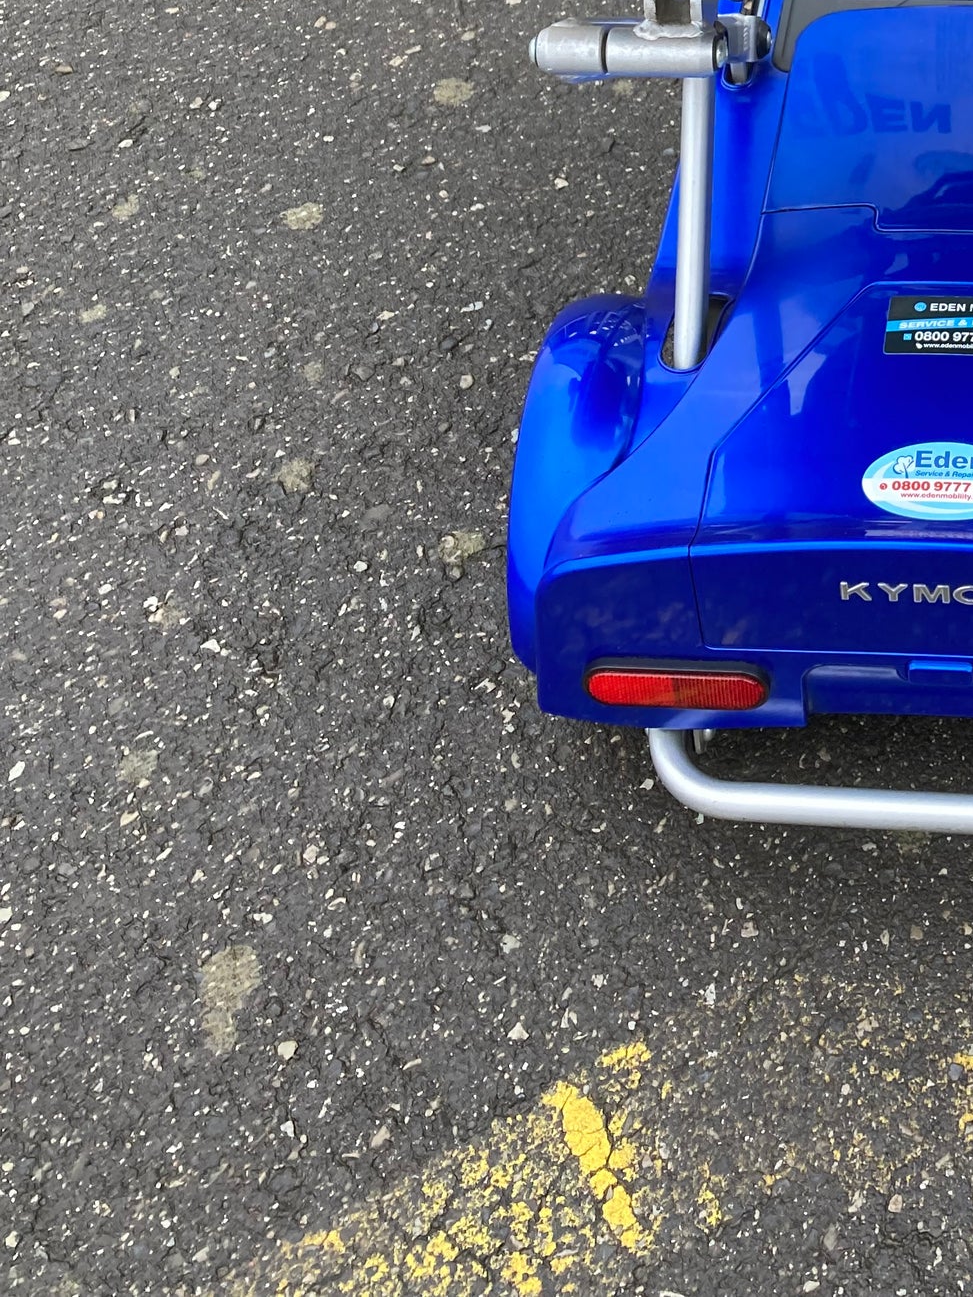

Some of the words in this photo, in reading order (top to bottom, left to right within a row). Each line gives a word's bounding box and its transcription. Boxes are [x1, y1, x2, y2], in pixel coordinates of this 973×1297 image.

[929, 302, 967, 313] EDEN
[898, 319, 956, 330] SERVICE
[957, 318, 968, 327] &
[914, 330, 950, 342] 0800
[915, 469, 943, 478] Service
[944, 470, 950, 478] &
[891, 480, 931, 491] 0800
[933, 481, 972, 493] 9777
